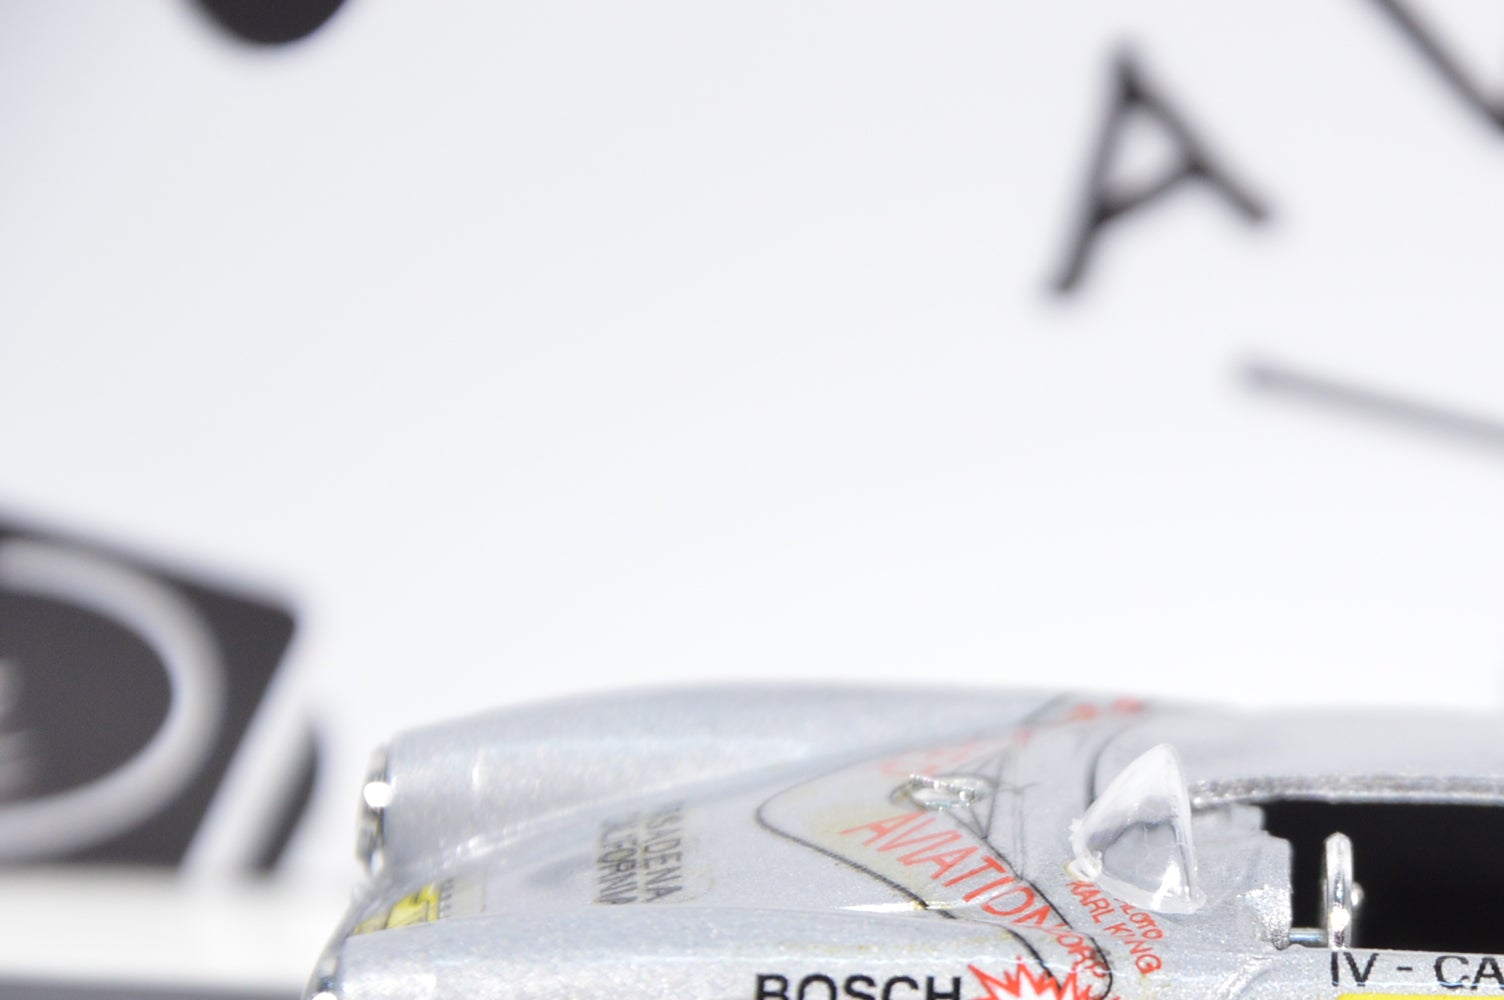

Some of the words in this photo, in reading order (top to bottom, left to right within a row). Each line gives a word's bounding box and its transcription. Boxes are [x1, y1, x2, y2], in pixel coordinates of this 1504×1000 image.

[1045, 45, 1272, 302] A
[839, 809, 1068, 929] AVIATION
[1065, 880, 1116, 925] KARL
[1103, 921, 1164, 976] KING
[1330, 951, 1380, 988] IV
